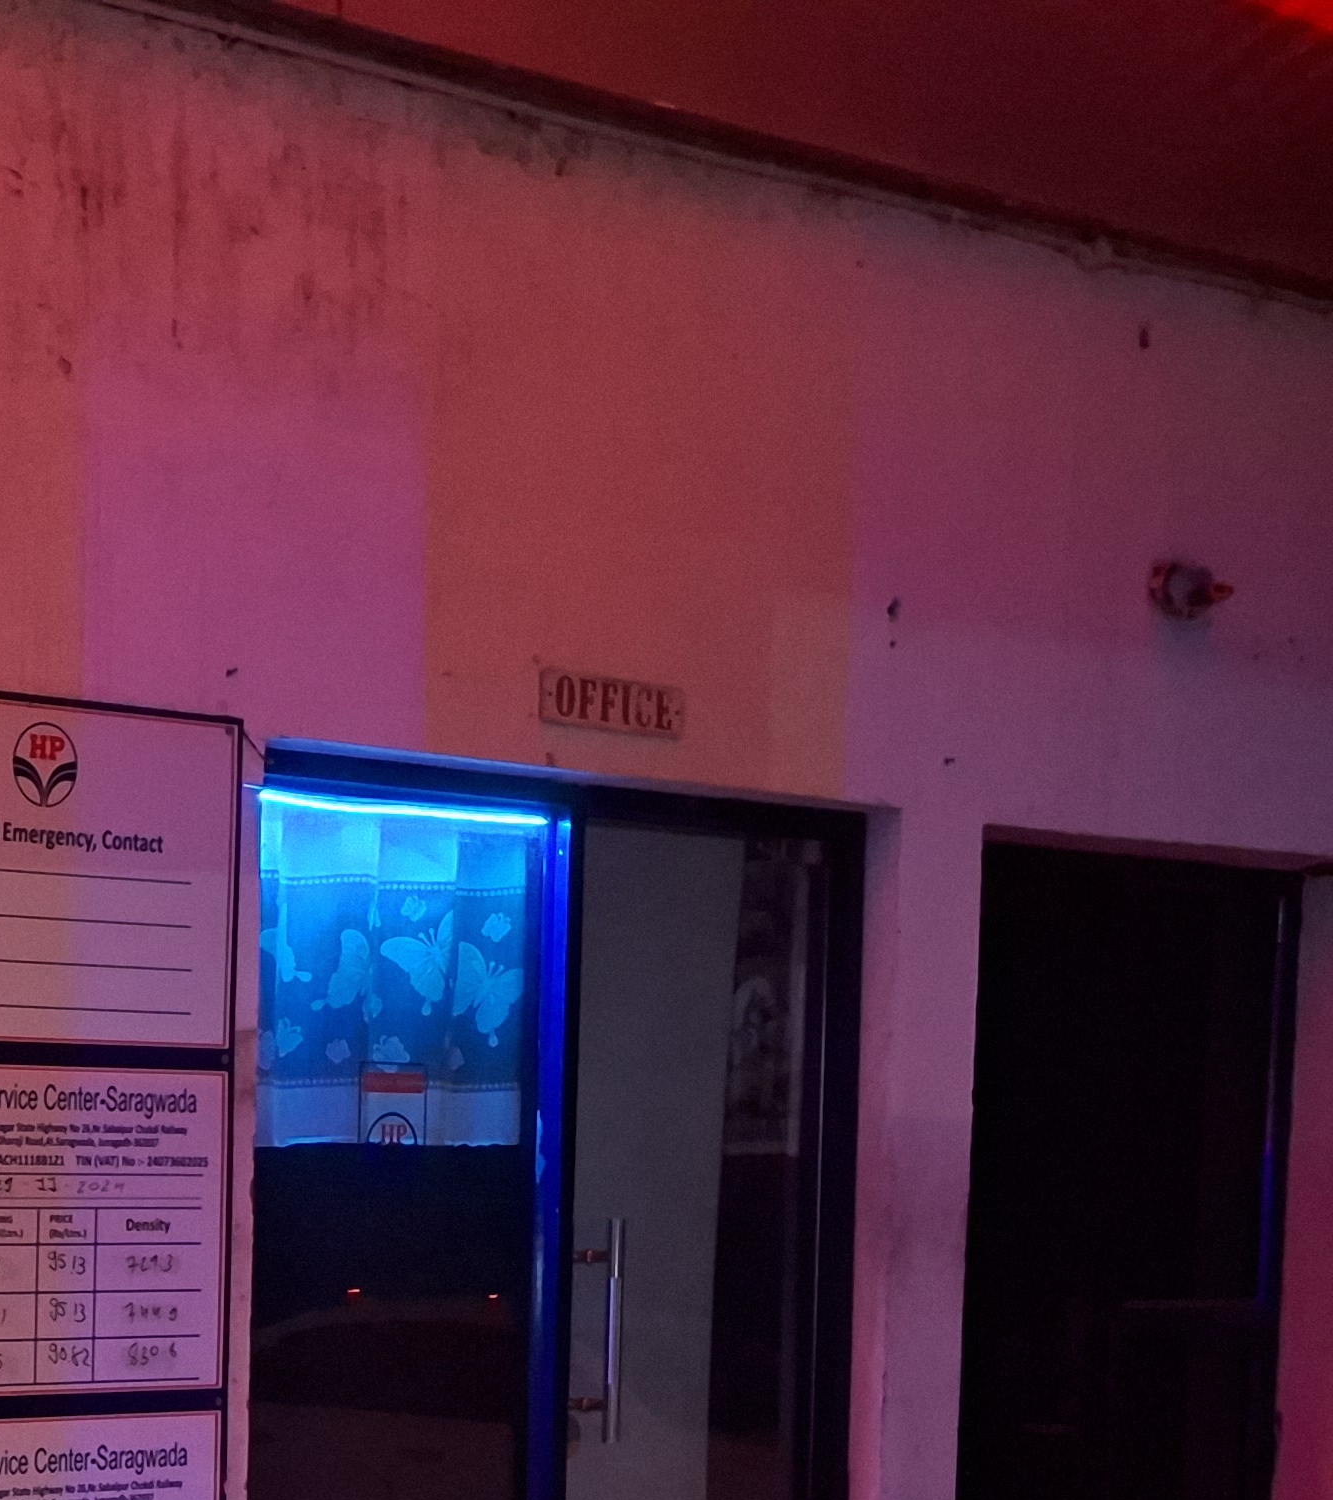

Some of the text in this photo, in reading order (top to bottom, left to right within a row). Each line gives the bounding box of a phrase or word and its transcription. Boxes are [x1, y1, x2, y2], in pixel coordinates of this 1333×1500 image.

[555, 674, 673, 731] OFFICE
[29, 733, 65, 761] HP
[2, 821, 98, 852] Emergency,
[102, 831, 164, 854] Contact
[43, 1083, 197, 1120] Center-Saragwada
[126, 1217, 171, 1235] Density
[34, 1442, 188, 1475] Center-Saragwada
